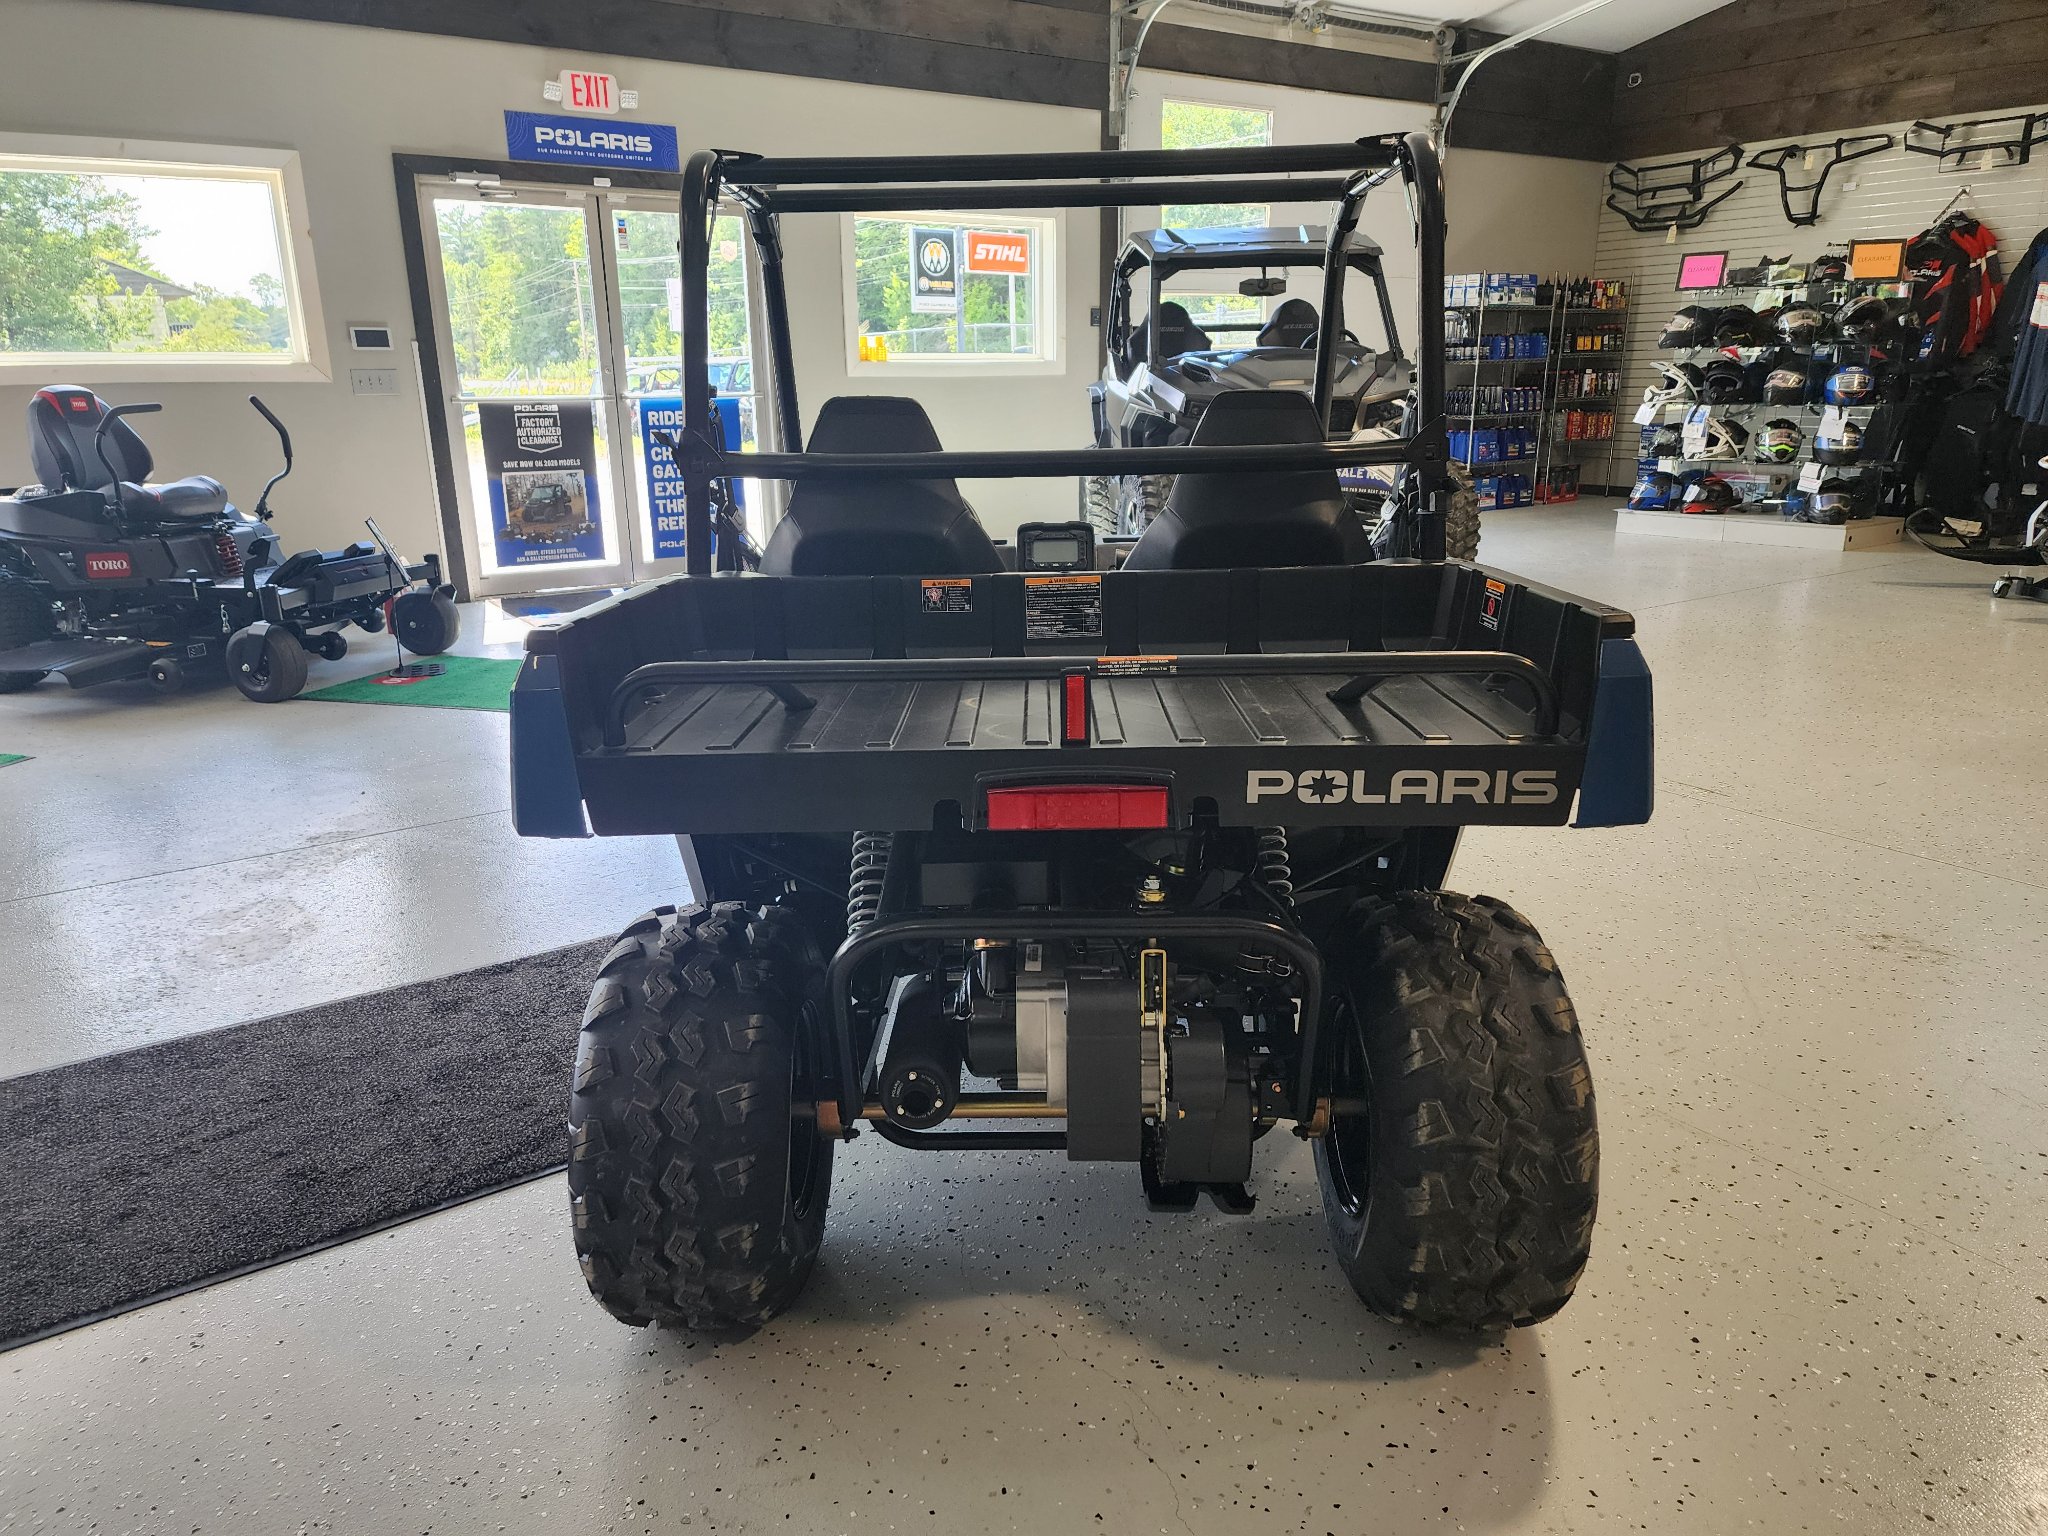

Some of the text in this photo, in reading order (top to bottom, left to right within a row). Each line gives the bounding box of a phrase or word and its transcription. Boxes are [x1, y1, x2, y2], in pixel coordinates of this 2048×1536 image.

[571, 73, 609, 108] EXIT
[534, 126, 653, 153] POLARIS
[974, 243, 1026, 262] STIHL
[513, 404, 558, 412] POLARIS
[521, 417, 554, 427] FACTORY
[516, 427, 562, 437] AUTHORIZED
[521, 436, 559, 445] CLEARANCE
[651, 447, 674, 461] CH
[519, 460, 534, 468] NOW
[559, 458, 581, 466] MODELS
[652, 464, 682, 479] GAT
[655, 499, 686, 514] THR
[89, 559, 127, 571] TORO
[1246, 770, 1559, 804] POLARIS
